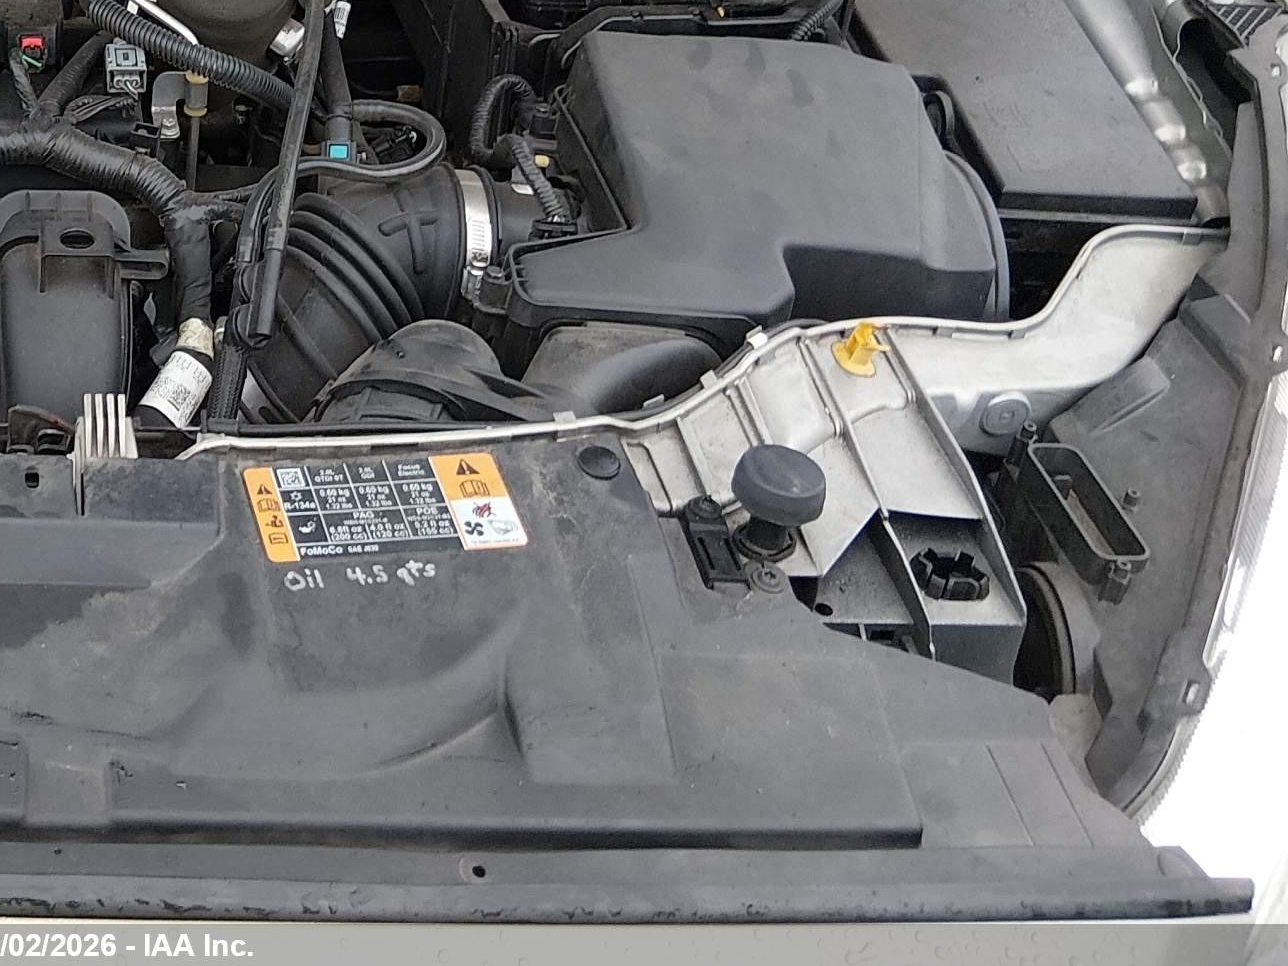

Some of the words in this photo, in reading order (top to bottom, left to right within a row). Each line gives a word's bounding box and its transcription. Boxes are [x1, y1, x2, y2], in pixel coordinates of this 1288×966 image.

[377, 485, 389, 494] kg
[402, 483, 420, 492] 0.60
[421, 483, 433, 492] kg
[319, 489, 337, 497] 0.60
[338, 488, 350, 497] kg
[284, 501, 316, 510] R-134a
[353, 511, 374, 519] PAG
[331, 533, 351, 542] (200
[300, 546, 343, 556] FoMoCo
[284, 568, 324, 591] Oil
[346, 564, 388, 586] 4.5
[396, 559, 436, 586] qts
